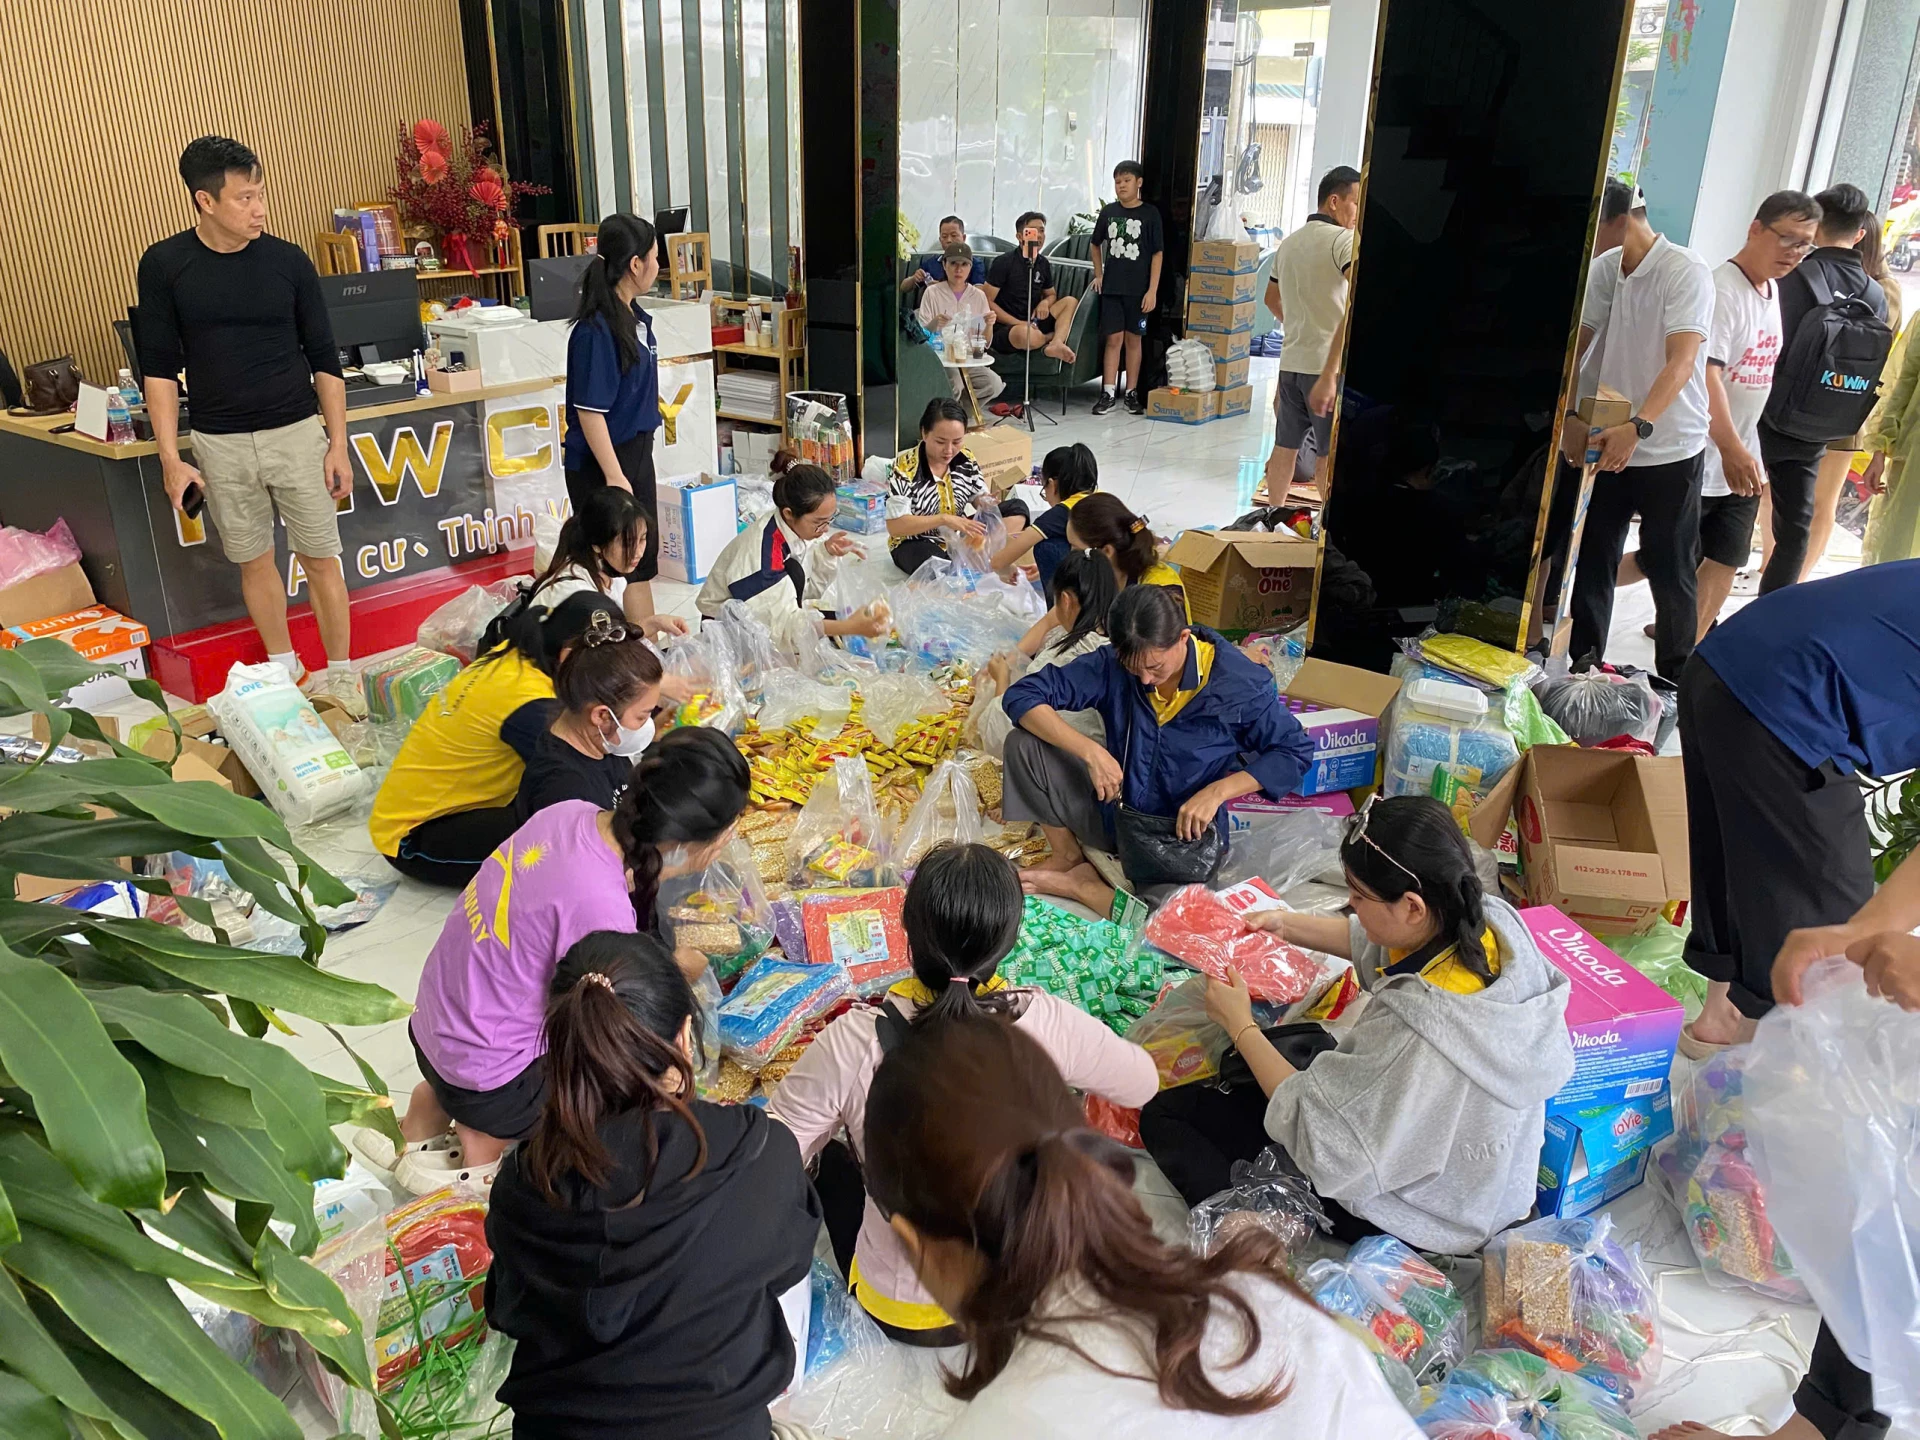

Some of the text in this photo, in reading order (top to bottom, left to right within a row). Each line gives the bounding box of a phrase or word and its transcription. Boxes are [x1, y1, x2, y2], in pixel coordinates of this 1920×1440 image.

[342, 284, 367, 296] msi
[1757, 329, 1777, 348] Los
[1258, 577, 1293, 595] One
[235, 681, 264, 697] LOVE
[1319, 728, 1367, 750] Vikoda
[1573, 864, 1588, 873] 412
[1595, 866, 1610, 875] 235
[1617, 869, 1632, 877] 178
[1632, 871, 1648, 879] mm
[1548, 926, 1628, 986] Vikoda
